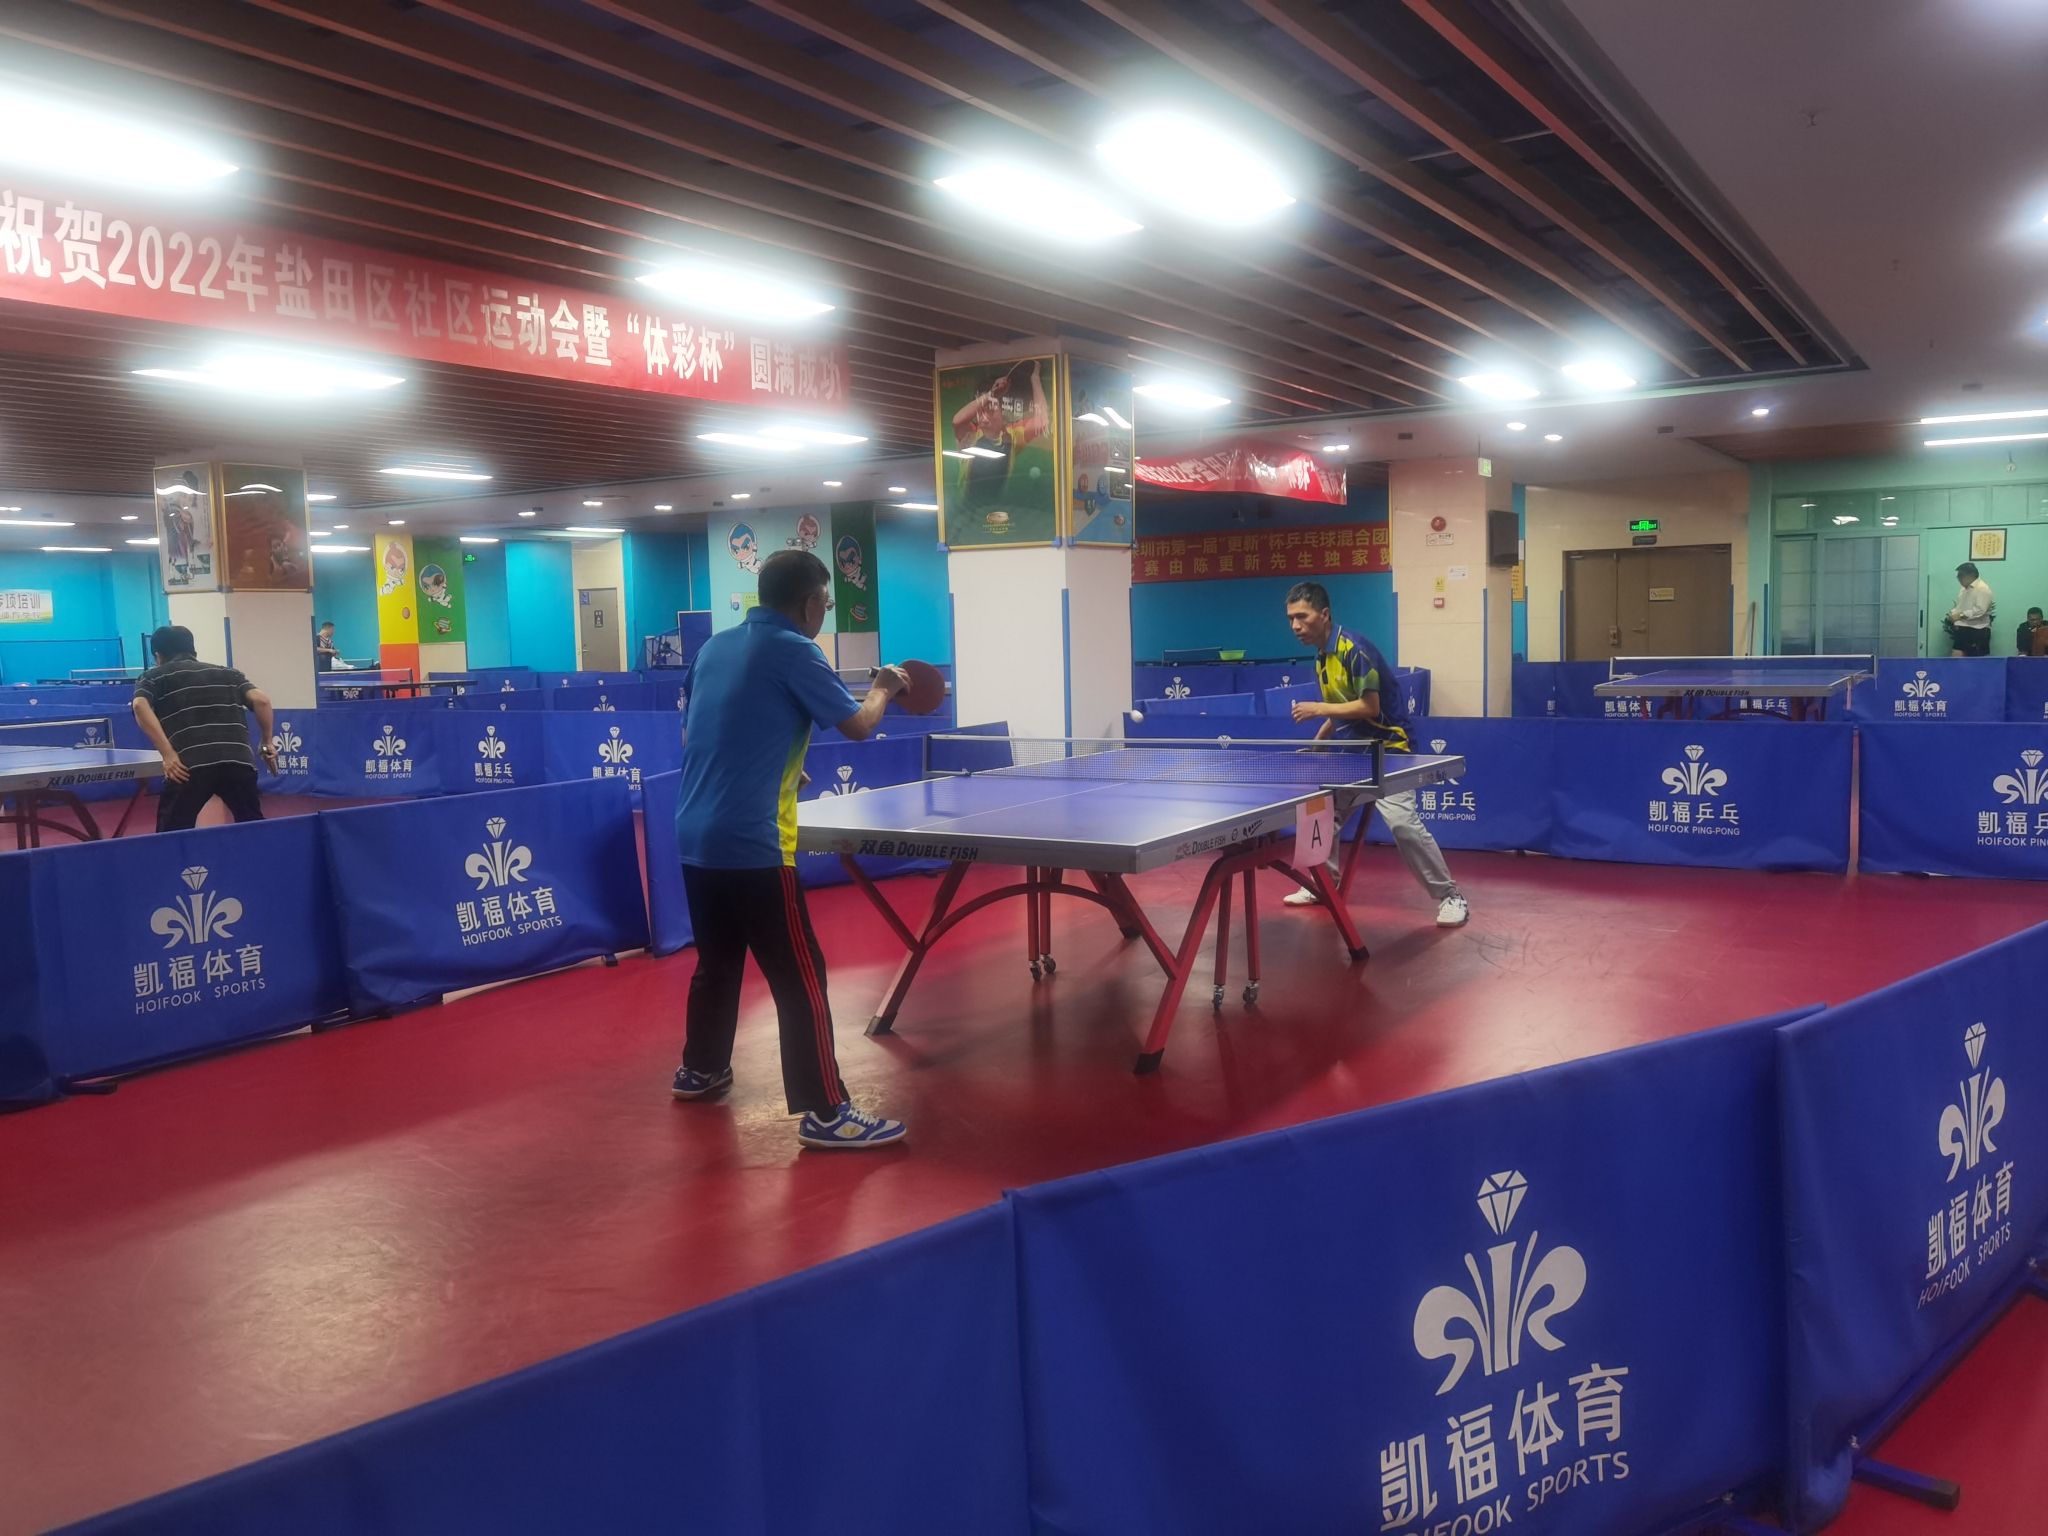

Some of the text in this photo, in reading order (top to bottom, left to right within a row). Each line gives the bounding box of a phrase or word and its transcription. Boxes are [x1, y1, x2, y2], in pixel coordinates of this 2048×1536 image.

[77, 771, 114, 784] DOUBLE
[114, 770, 135, 779] FISH
[1437, 813, 1477, 821] PING-PONG
[1310, 819, 1322, 850] A
[1648, 824, 1741, 836] HOIFOOK PING-PONG
[858, 839, 979, 860] 双鱼 DOUBLE FISH
[1191, 838, 1214, 855] DOUBLE
[1977, 836, 2027, 847] HOIFOOK
[462, 915, 563, 946] HOIFOOK SPORTS
[135, 978, 267, 1015] HOIFOOK SPORTS
[1916, 1221, 2012, 1310] HOIFOOK SPORTS
[1526, 1450, 1631, 1512] SPORTS
